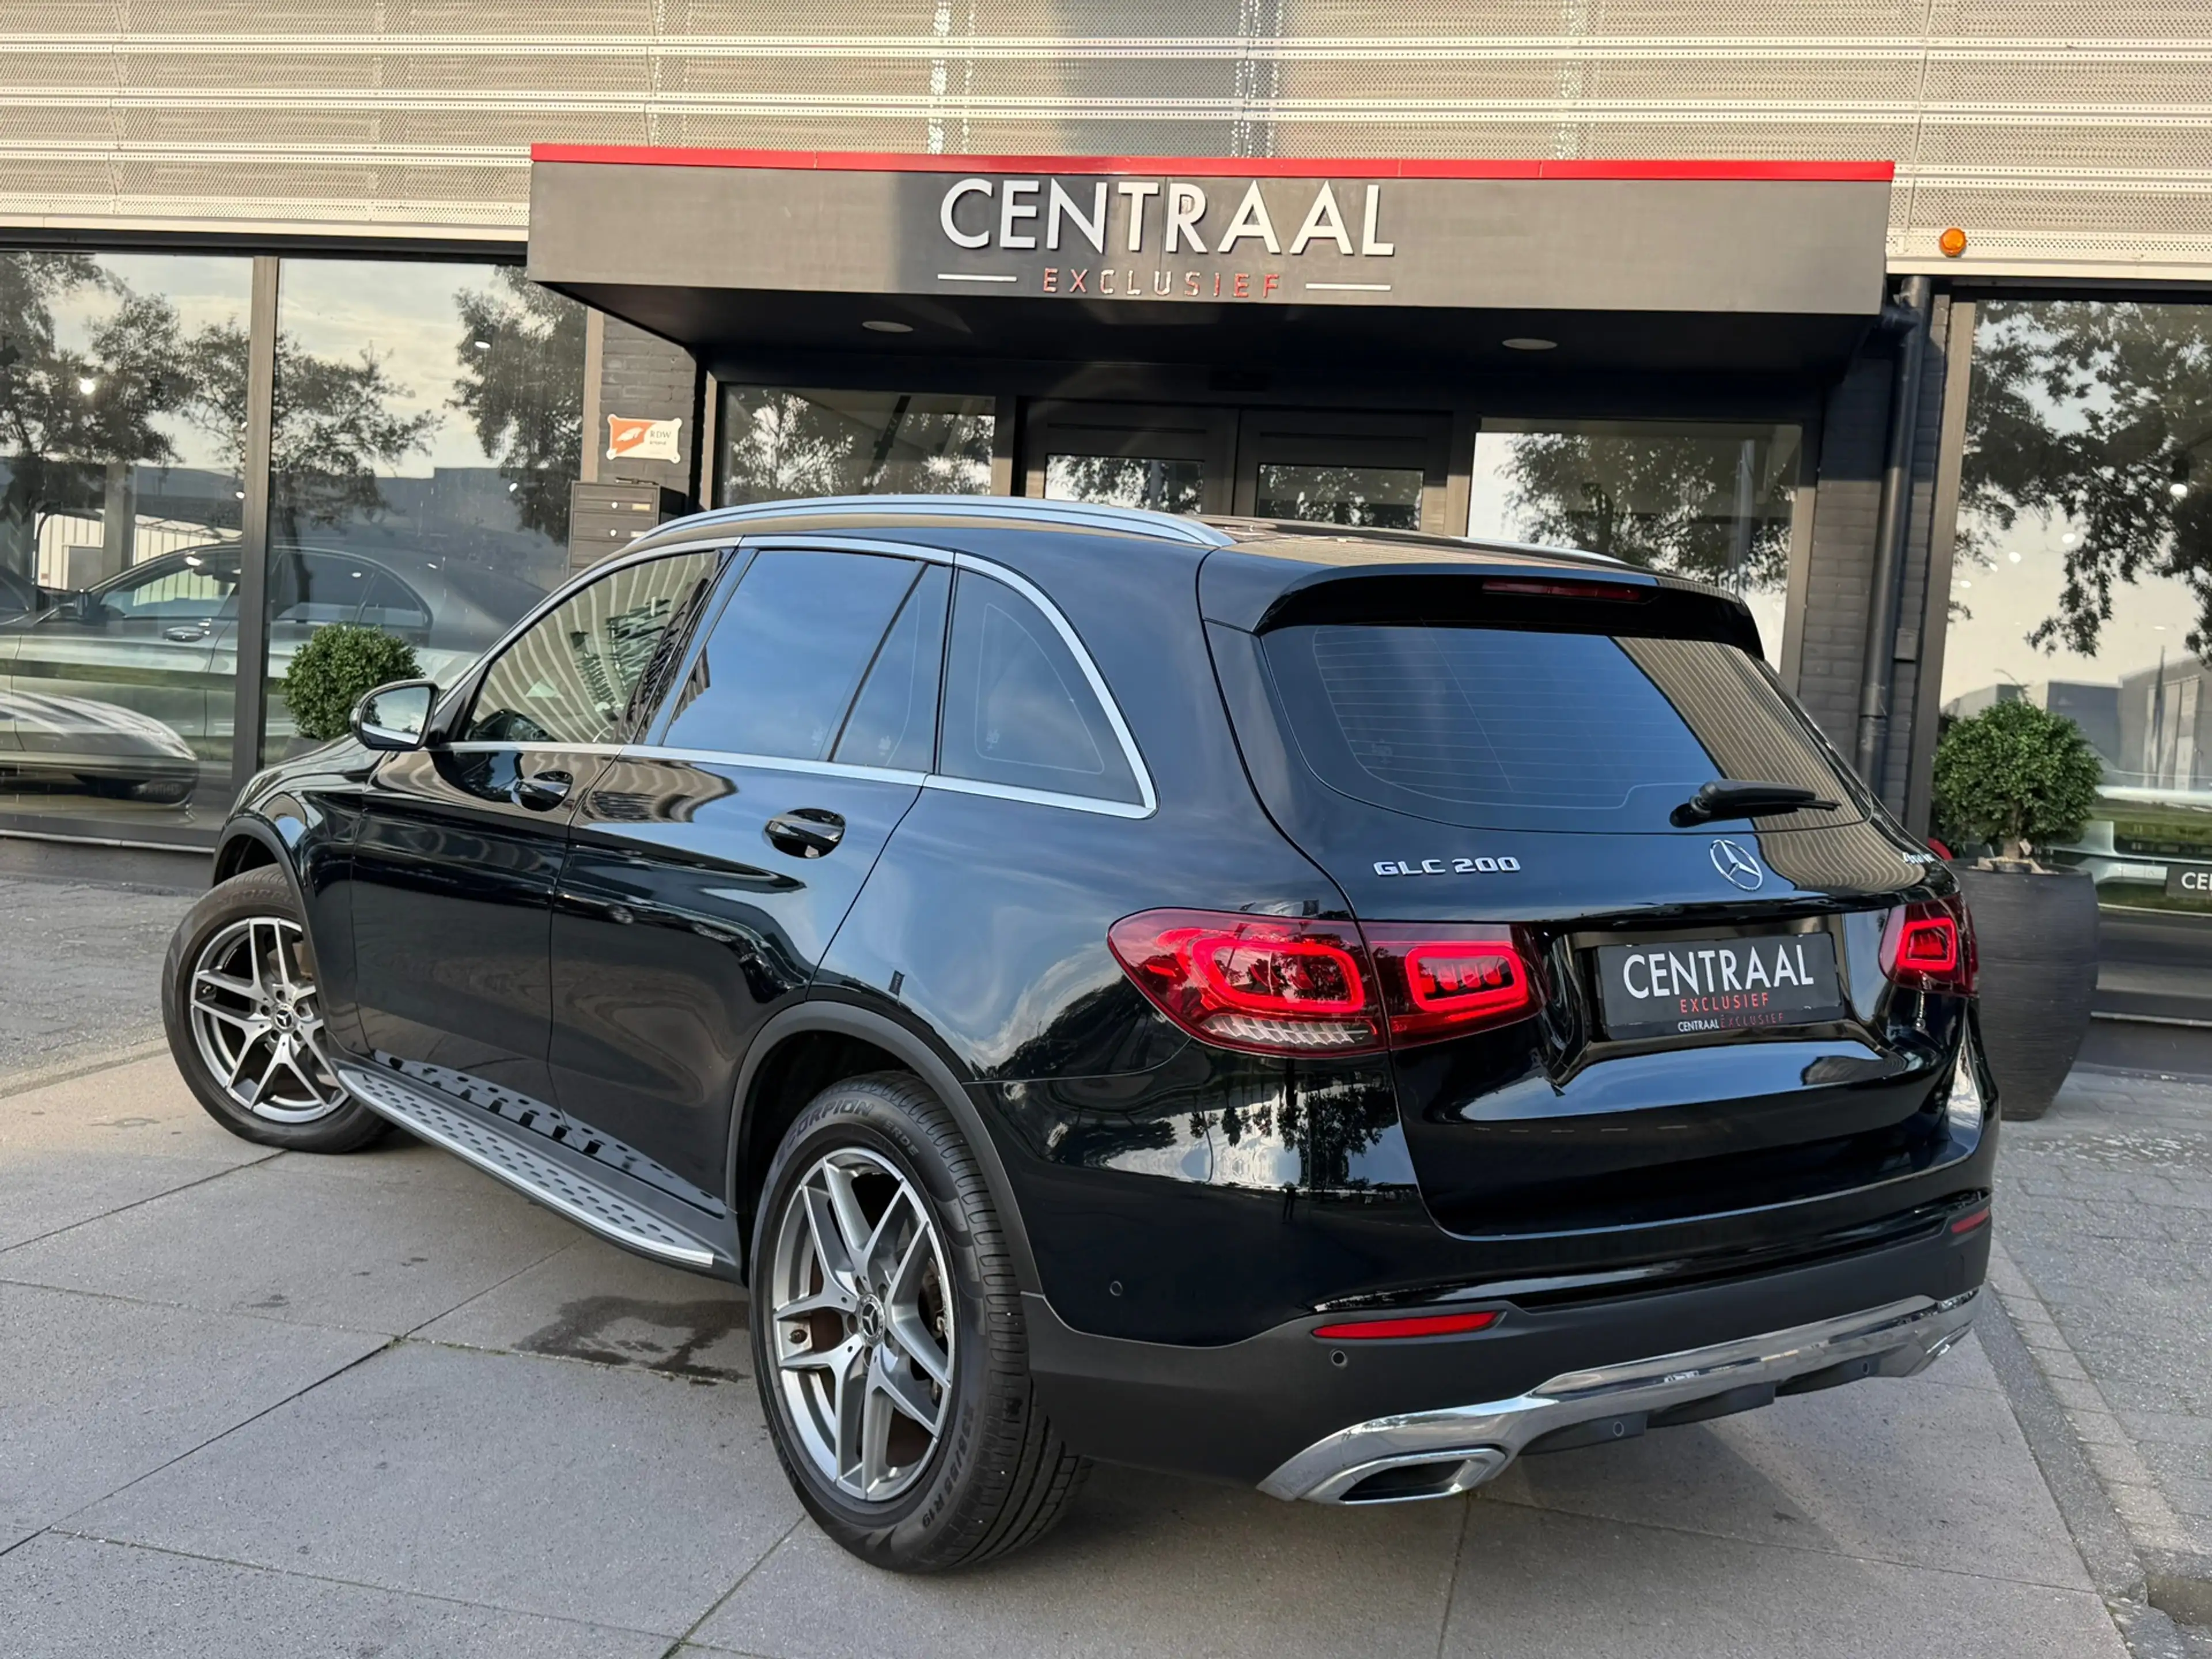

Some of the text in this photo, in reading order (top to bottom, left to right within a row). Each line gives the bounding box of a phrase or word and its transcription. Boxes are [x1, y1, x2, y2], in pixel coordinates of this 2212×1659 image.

[940, 178, 1394, 256] CENTRAAL
[1043, 267, 1281, 298] EXCLUSIEF
[1373, 857, 1521, 876] GLC 200
[1623, 944, 1814, 999] CENTRAAL
[1680, 992, 1769, 1013] EXCLUSIEF
[1677, 1013, 1784, 1032] CENTRAAL EXCLUSIEF
[880, 1117, 919, 1157] ERDE
